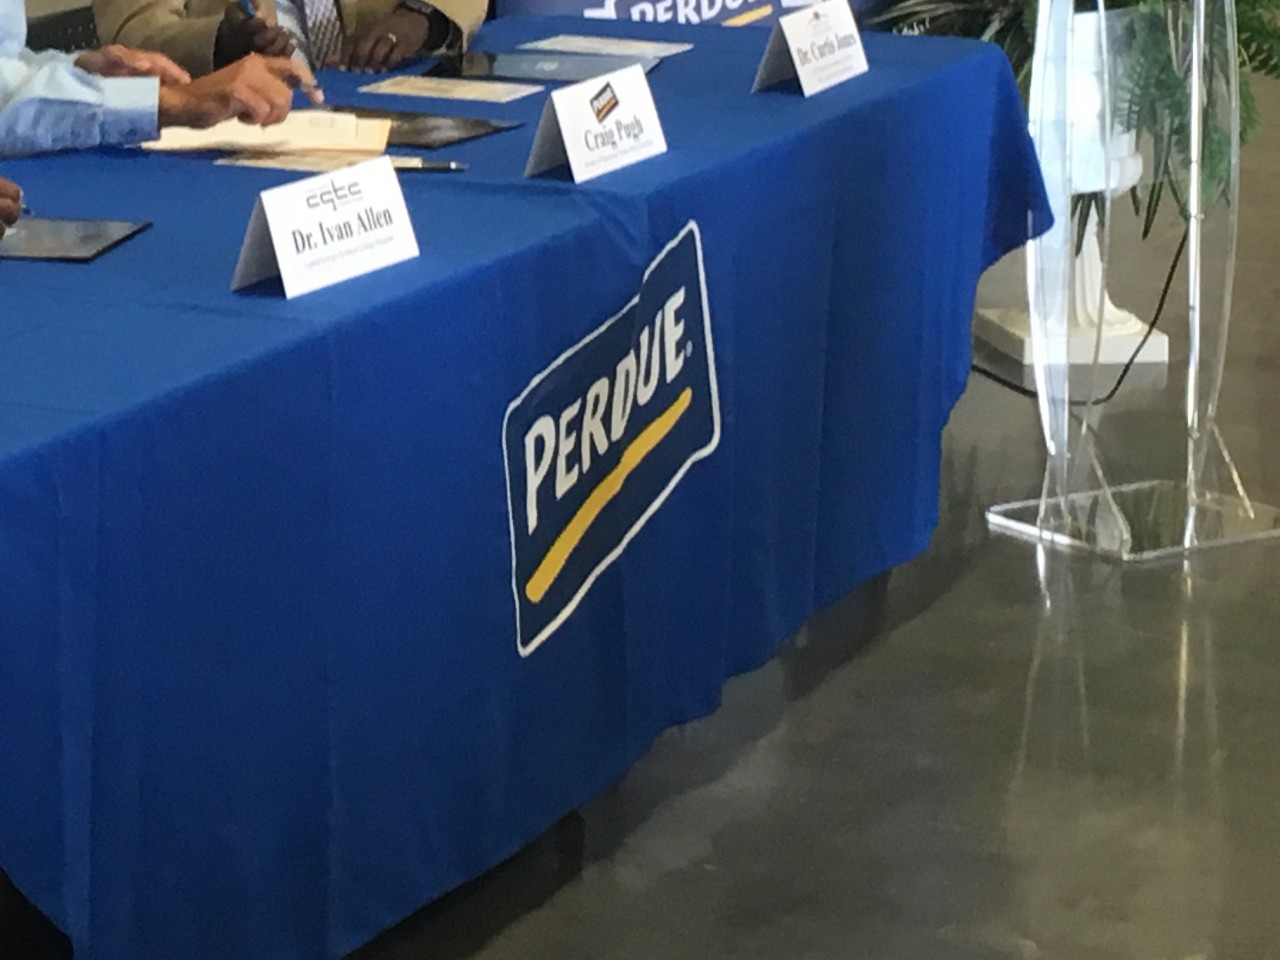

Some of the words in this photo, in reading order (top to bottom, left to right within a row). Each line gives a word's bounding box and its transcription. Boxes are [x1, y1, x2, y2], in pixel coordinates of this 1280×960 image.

[584, 125, 618, 152] Craig
[615, 114, 644, 143] Pugh
[291, 229, 318, 255] Dr.
[319, 221, 354, 246] Ivan
[356, 206, 393, 236] Allen
[524, 285, 685, 535] PERDUE
